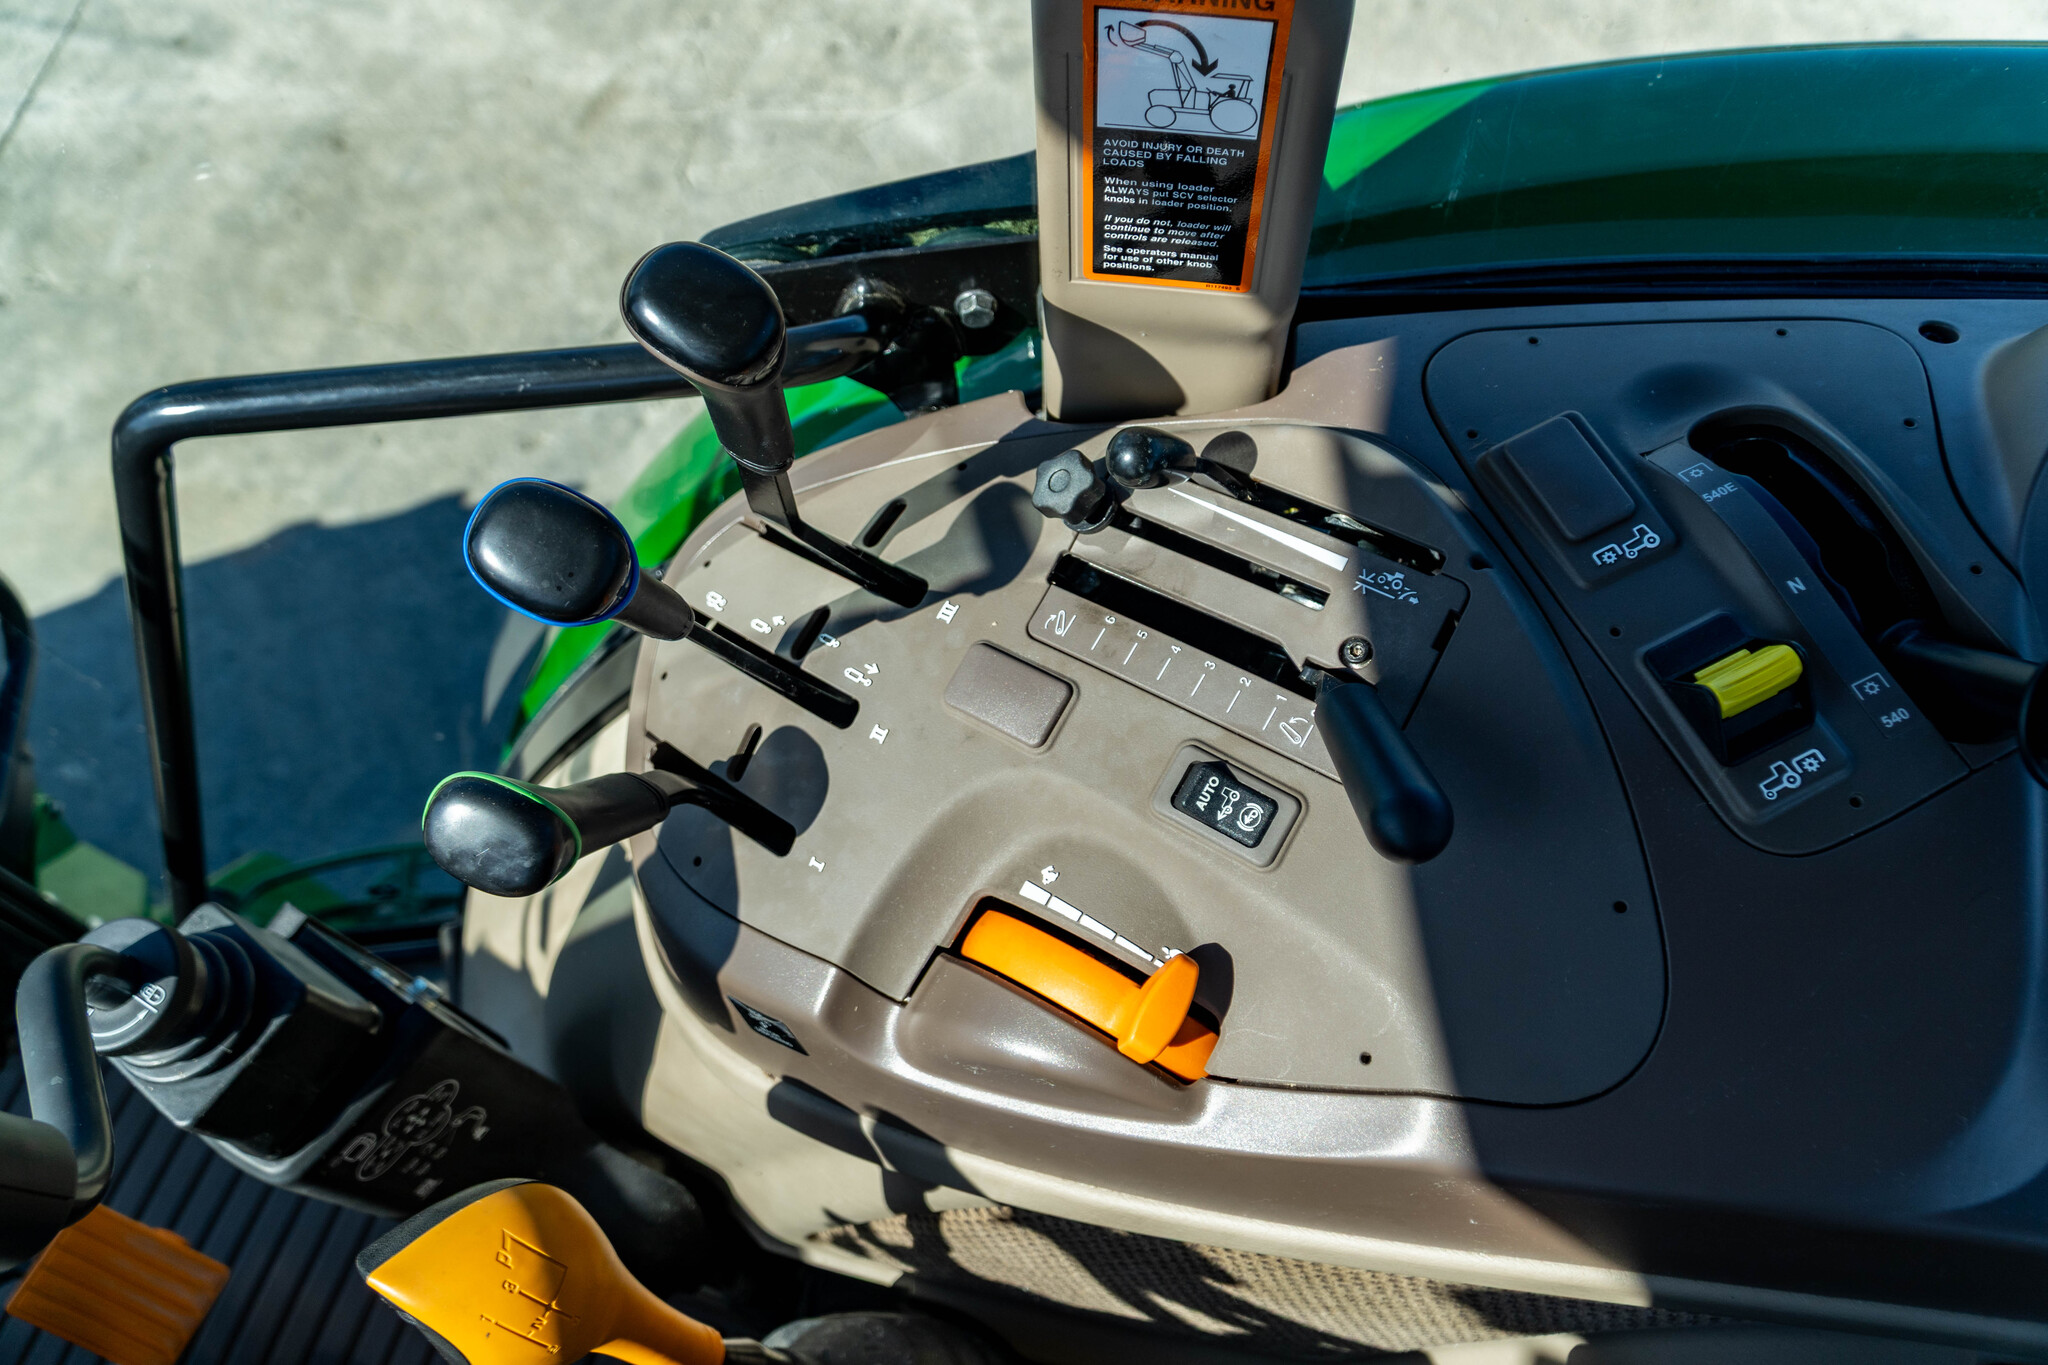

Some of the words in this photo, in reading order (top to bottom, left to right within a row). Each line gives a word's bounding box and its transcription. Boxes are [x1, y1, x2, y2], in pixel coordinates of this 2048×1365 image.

[1104, 139, 1138, 148] AVOID
[1142, 141, 1182, 151] INJURY
[1187, 145, 1203, 153] OR
[1206, 147, 1245, 157] DEATH
[1103, 149, 1152, 159] CAUSED
[1176, 154, 1228, 166] FALLING
[1103, 158, 1144, 167] LOADS
[1104, 177, 1137, 186] When
[1142, 180, 1173, 190] using
[1178, 182, 1215, 192] loader
[1104, 186, 1149, 195] ALWAYS
[1153, 190, 1169, 198] put
[1173, 192, 1194, 200] SCV
[1197, 194, 1237, 203] selector
[1104, 195, 1135, 204] knobs
[1139, 197, 1148, 205] in
[1152, 198, 1184, 208] loader
[1187, 202, 1232, 213] position.
[1104, 224, 1150, 233] continue
[1168, 229, 1197, 237] move
[1200, 231, 1225, 240] after
[1114, 216, 1133, 224] you
[1153, 219, 1173, 227] not,
[1177, 221, 1210, 230] loader
[1214, 224, 1231, 232] will
[1104, 233, 1147, 241] controls
[1171, 238, 1219, 247] released.
[1127, 248, 1177, 258] operators
[1180, 249, 1218, 261] manual
[1156, 257, 1184, 266] other
[1187, 260, 1212, 268] knob
[1103, 261, 1154, 271] positions.
[1702, 482, 1738, 503] 540E
[1786, 576, 1806, 594] N
[1105, 615, 1116, 624] 6
[1136, 629, 1148, 639] 5
[1171, 645, 1182, 654] 4
[1204, 660, 1216, 670] 3
[1239, 677, 1252, 687] 2
[1880, 708, 1910, 728] 540
[1195, 776, 1220, 812] AUTO
[496, 1249, 514, 1270] P
[530, 1315, 548, 1331] N
